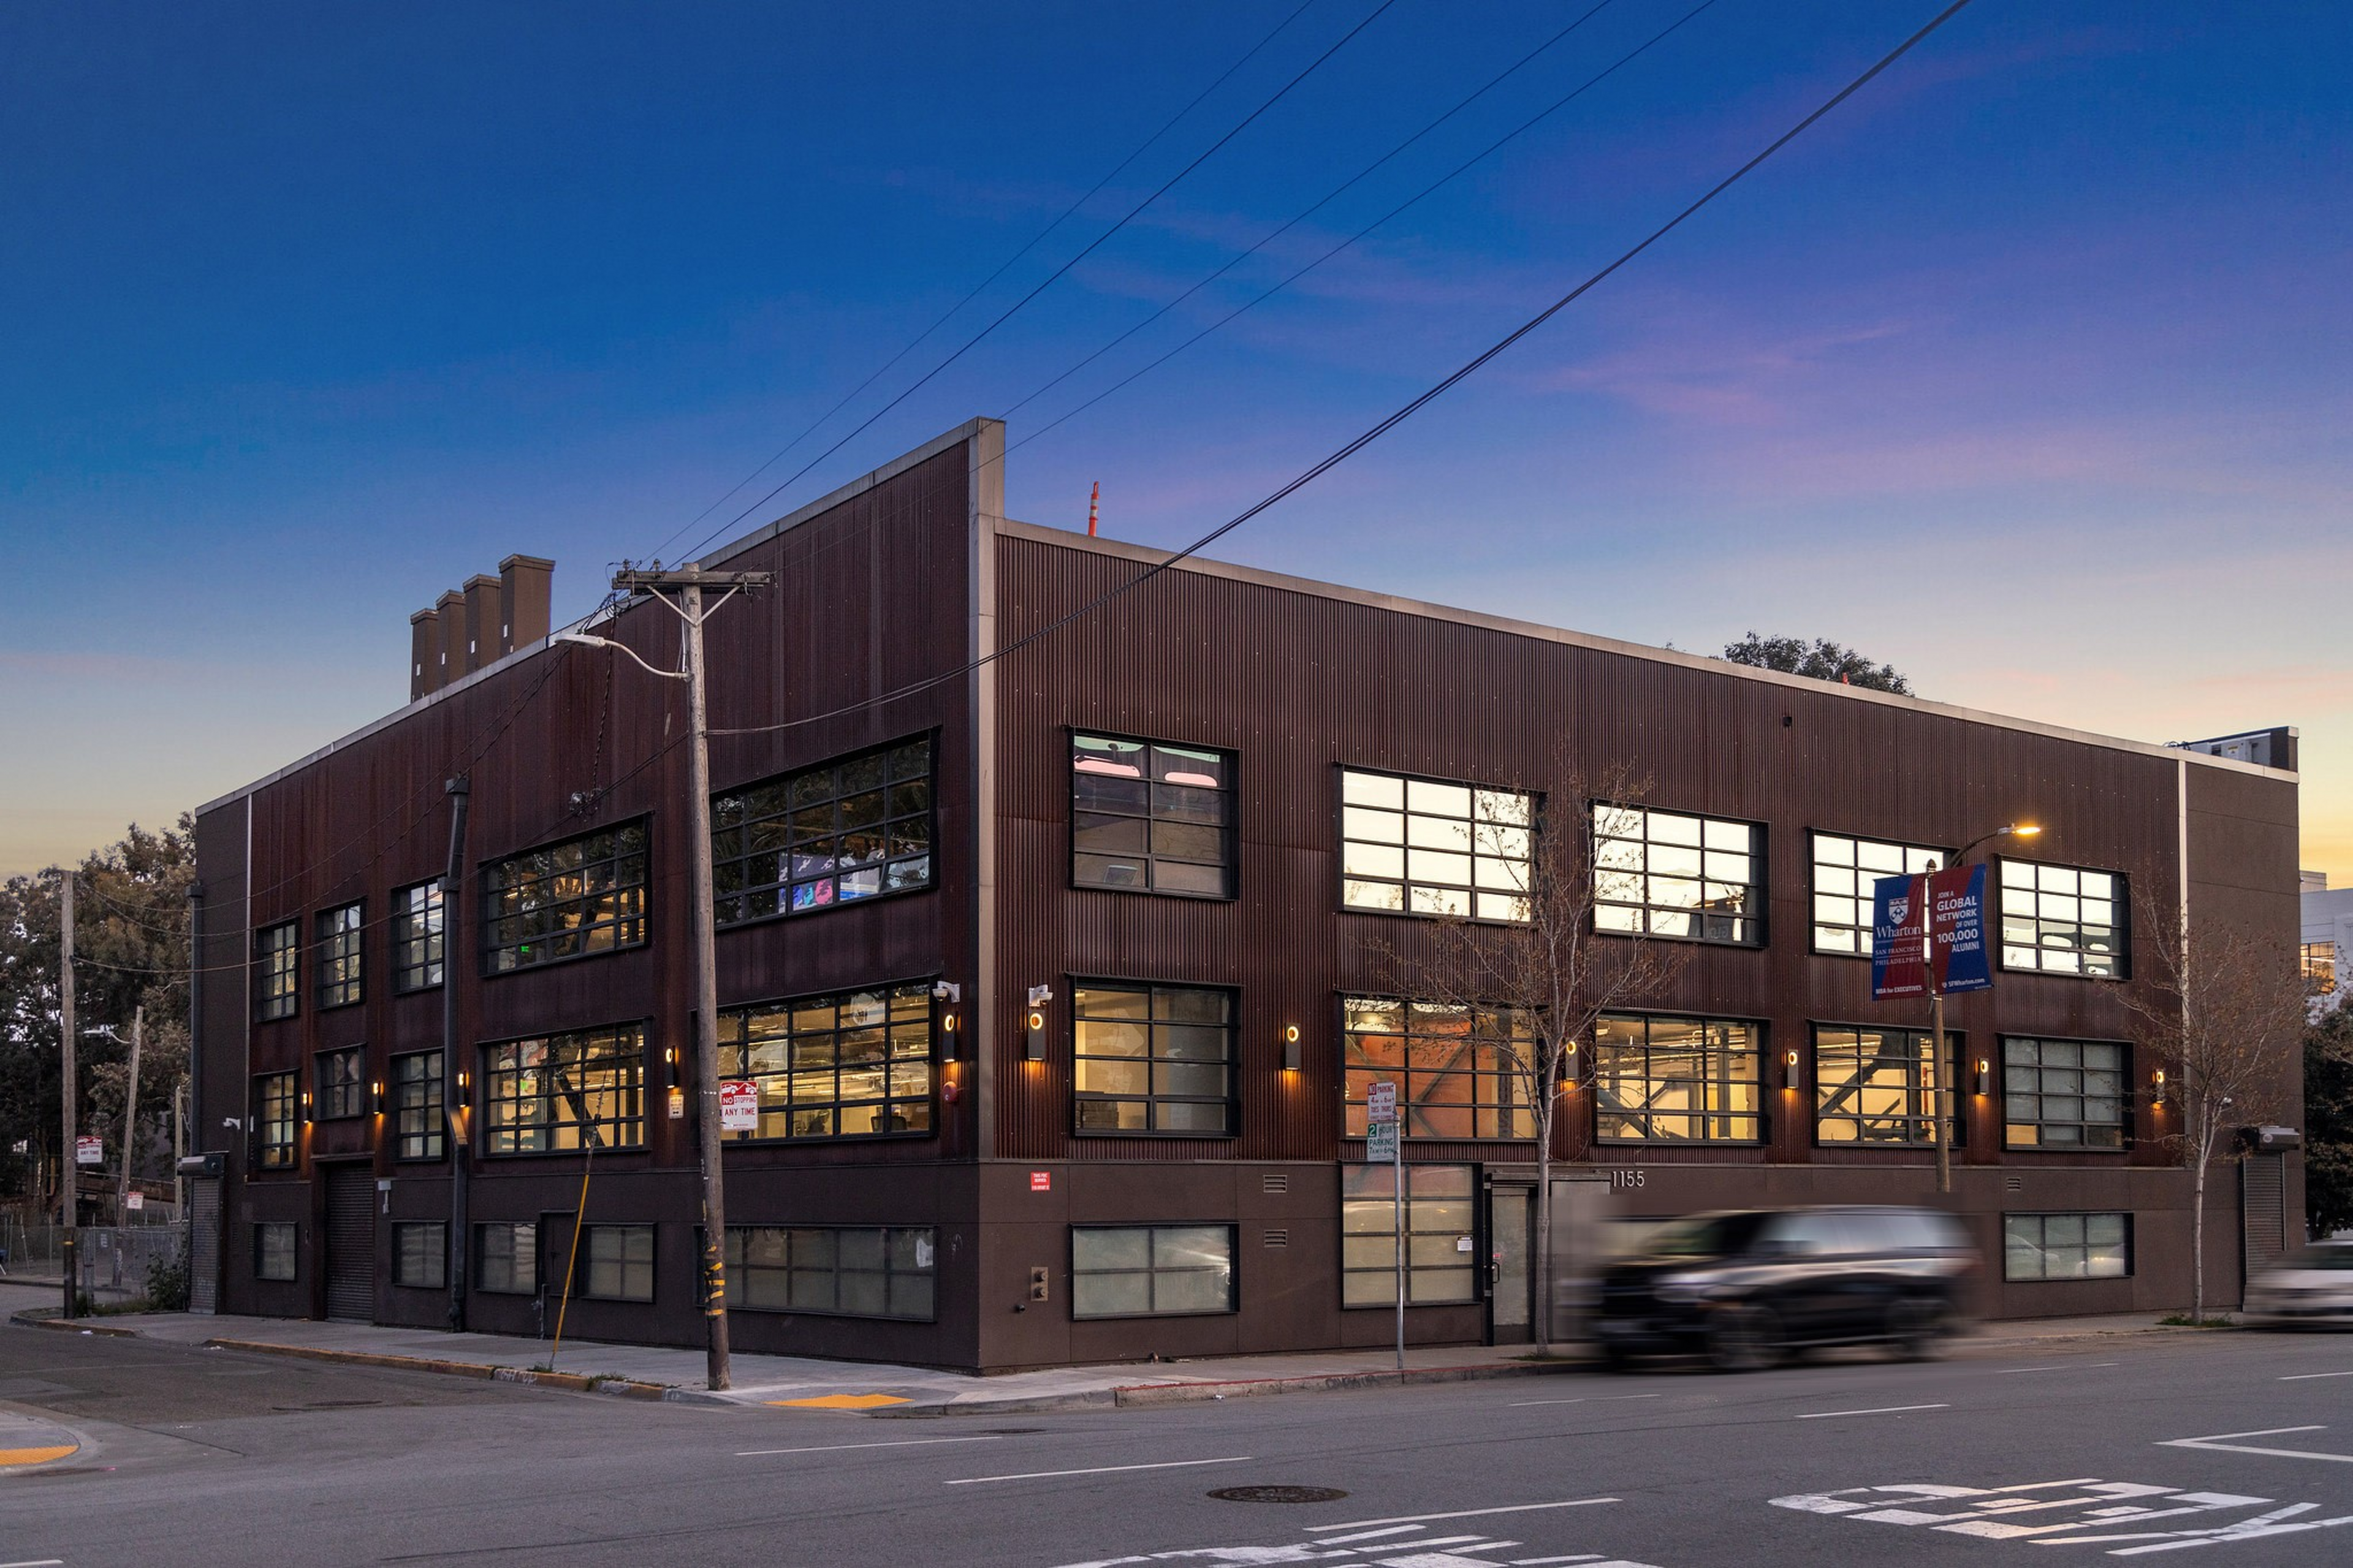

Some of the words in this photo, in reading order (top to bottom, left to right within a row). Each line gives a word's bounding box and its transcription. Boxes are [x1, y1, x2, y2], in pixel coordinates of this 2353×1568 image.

[1937, 895, 1977, 912] GLOBAL
[1936, 908, 1977, 923] NETWORK
[1876, 925, 1921, 938] Wharton
[1937, 928, 1978, 944] 100,000
[1888, 945, 1922, 954] FRANCISCO
[1952, 941, 1980, 953] ALUMNI
[1876, 956, 1922, 966] PHILADELPHIA
[1368, 1084, 1376, 1094] NO
[1377, 1085, 1394, 1093] PARKING
[724, 1108, 738, 1116] ANY
[741, 1107, 755, 1116] TIME
[1369, 1124, 1376, 1137] 2
[1379, 1125, 1393, 1134] HOUR
[1369, 1138, 1394, 1146] PARKING
[1613, 1171, 1644, 1187] 1155
